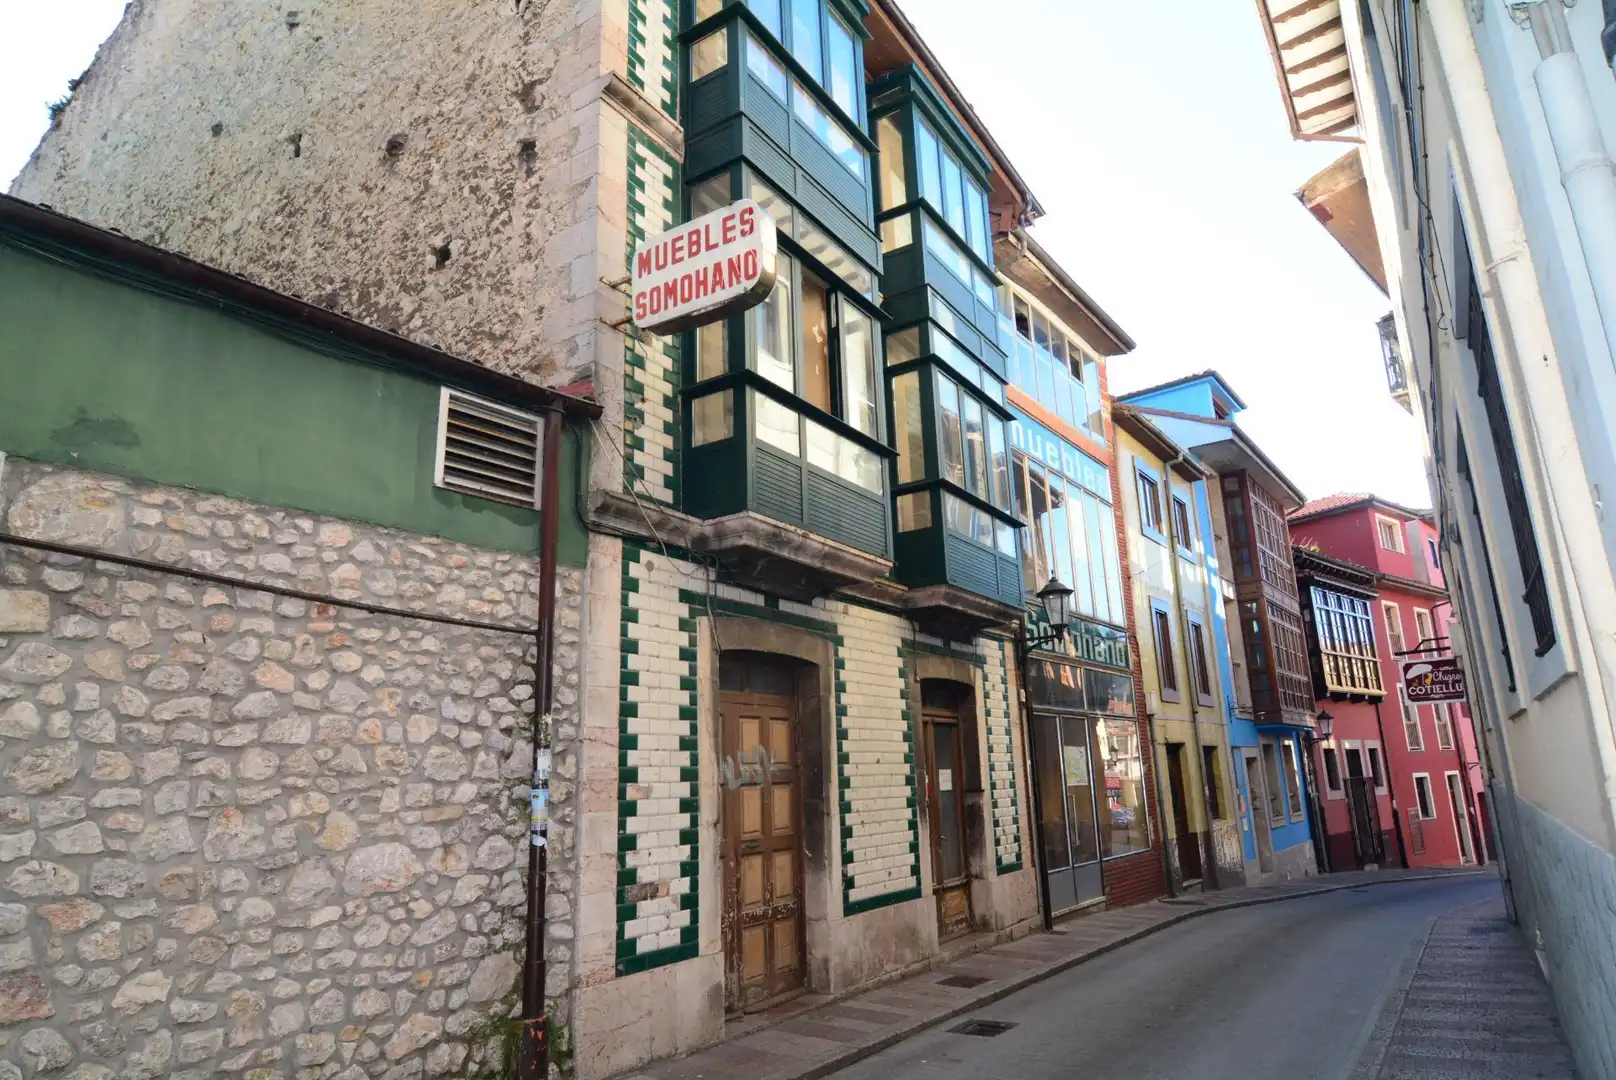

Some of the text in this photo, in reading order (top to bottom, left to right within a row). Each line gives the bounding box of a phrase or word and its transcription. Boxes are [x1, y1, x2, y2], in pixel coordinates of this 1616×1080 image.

[637, 206, 755, 279] MUEBLES
[635, 248, 758, 320] SOMOHANO
[1408, 683, 1464, 695] COTIELLU
[1432, 671, 1461, 685] Chigre
